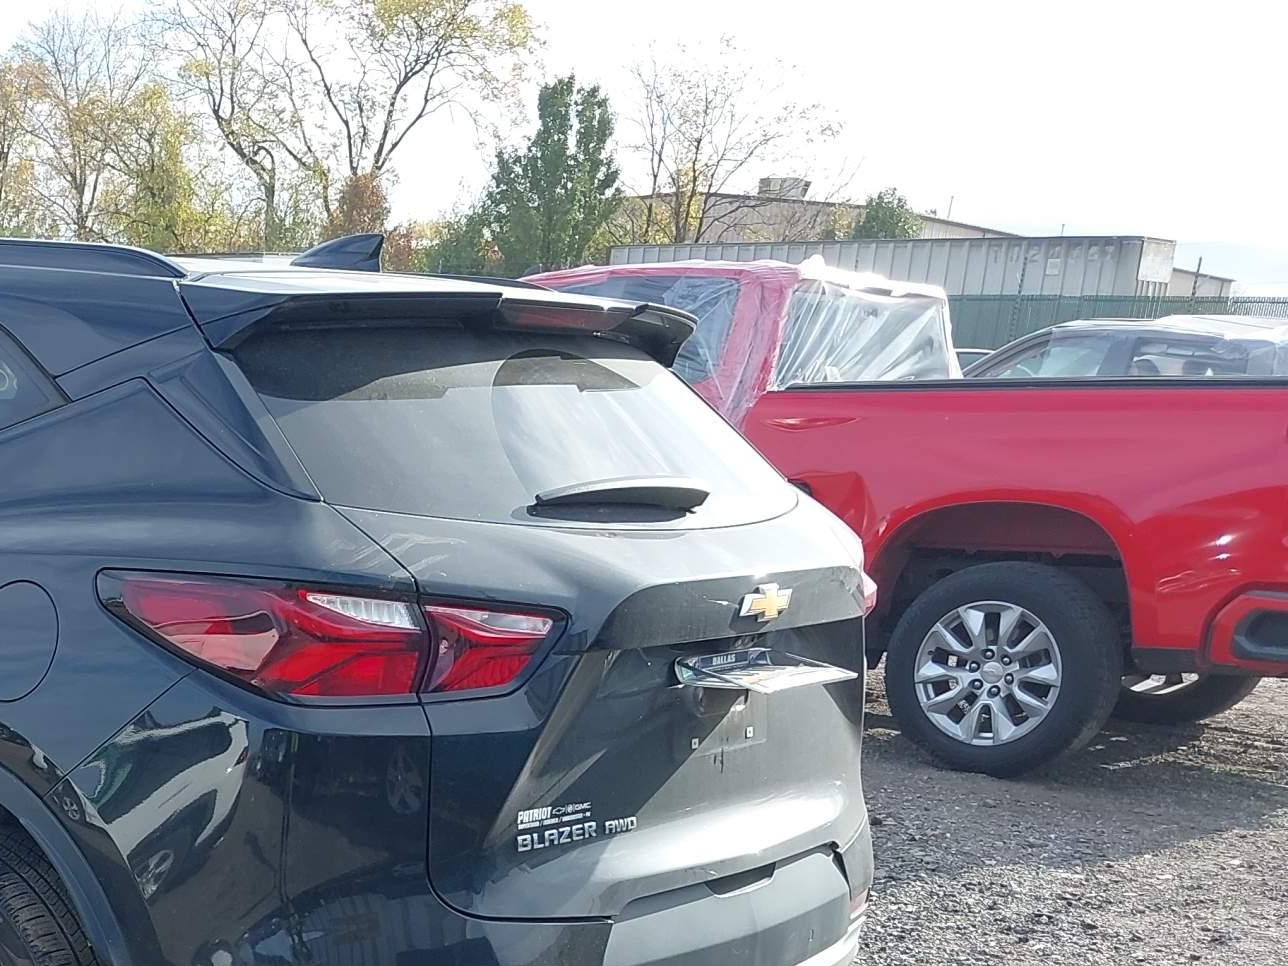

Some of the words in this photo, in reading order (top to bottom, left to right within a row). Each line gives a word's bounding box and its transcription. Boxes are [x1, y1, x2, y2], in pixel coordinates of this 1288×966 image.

[712, 654, 736, 666] DALLAS
[517, 806, 552, 824] PATRIOT
[574, 801, 592, 811] GMC
[516, 821, 597, 852] BLAZER
[605, 816, 637, 834] AWD
